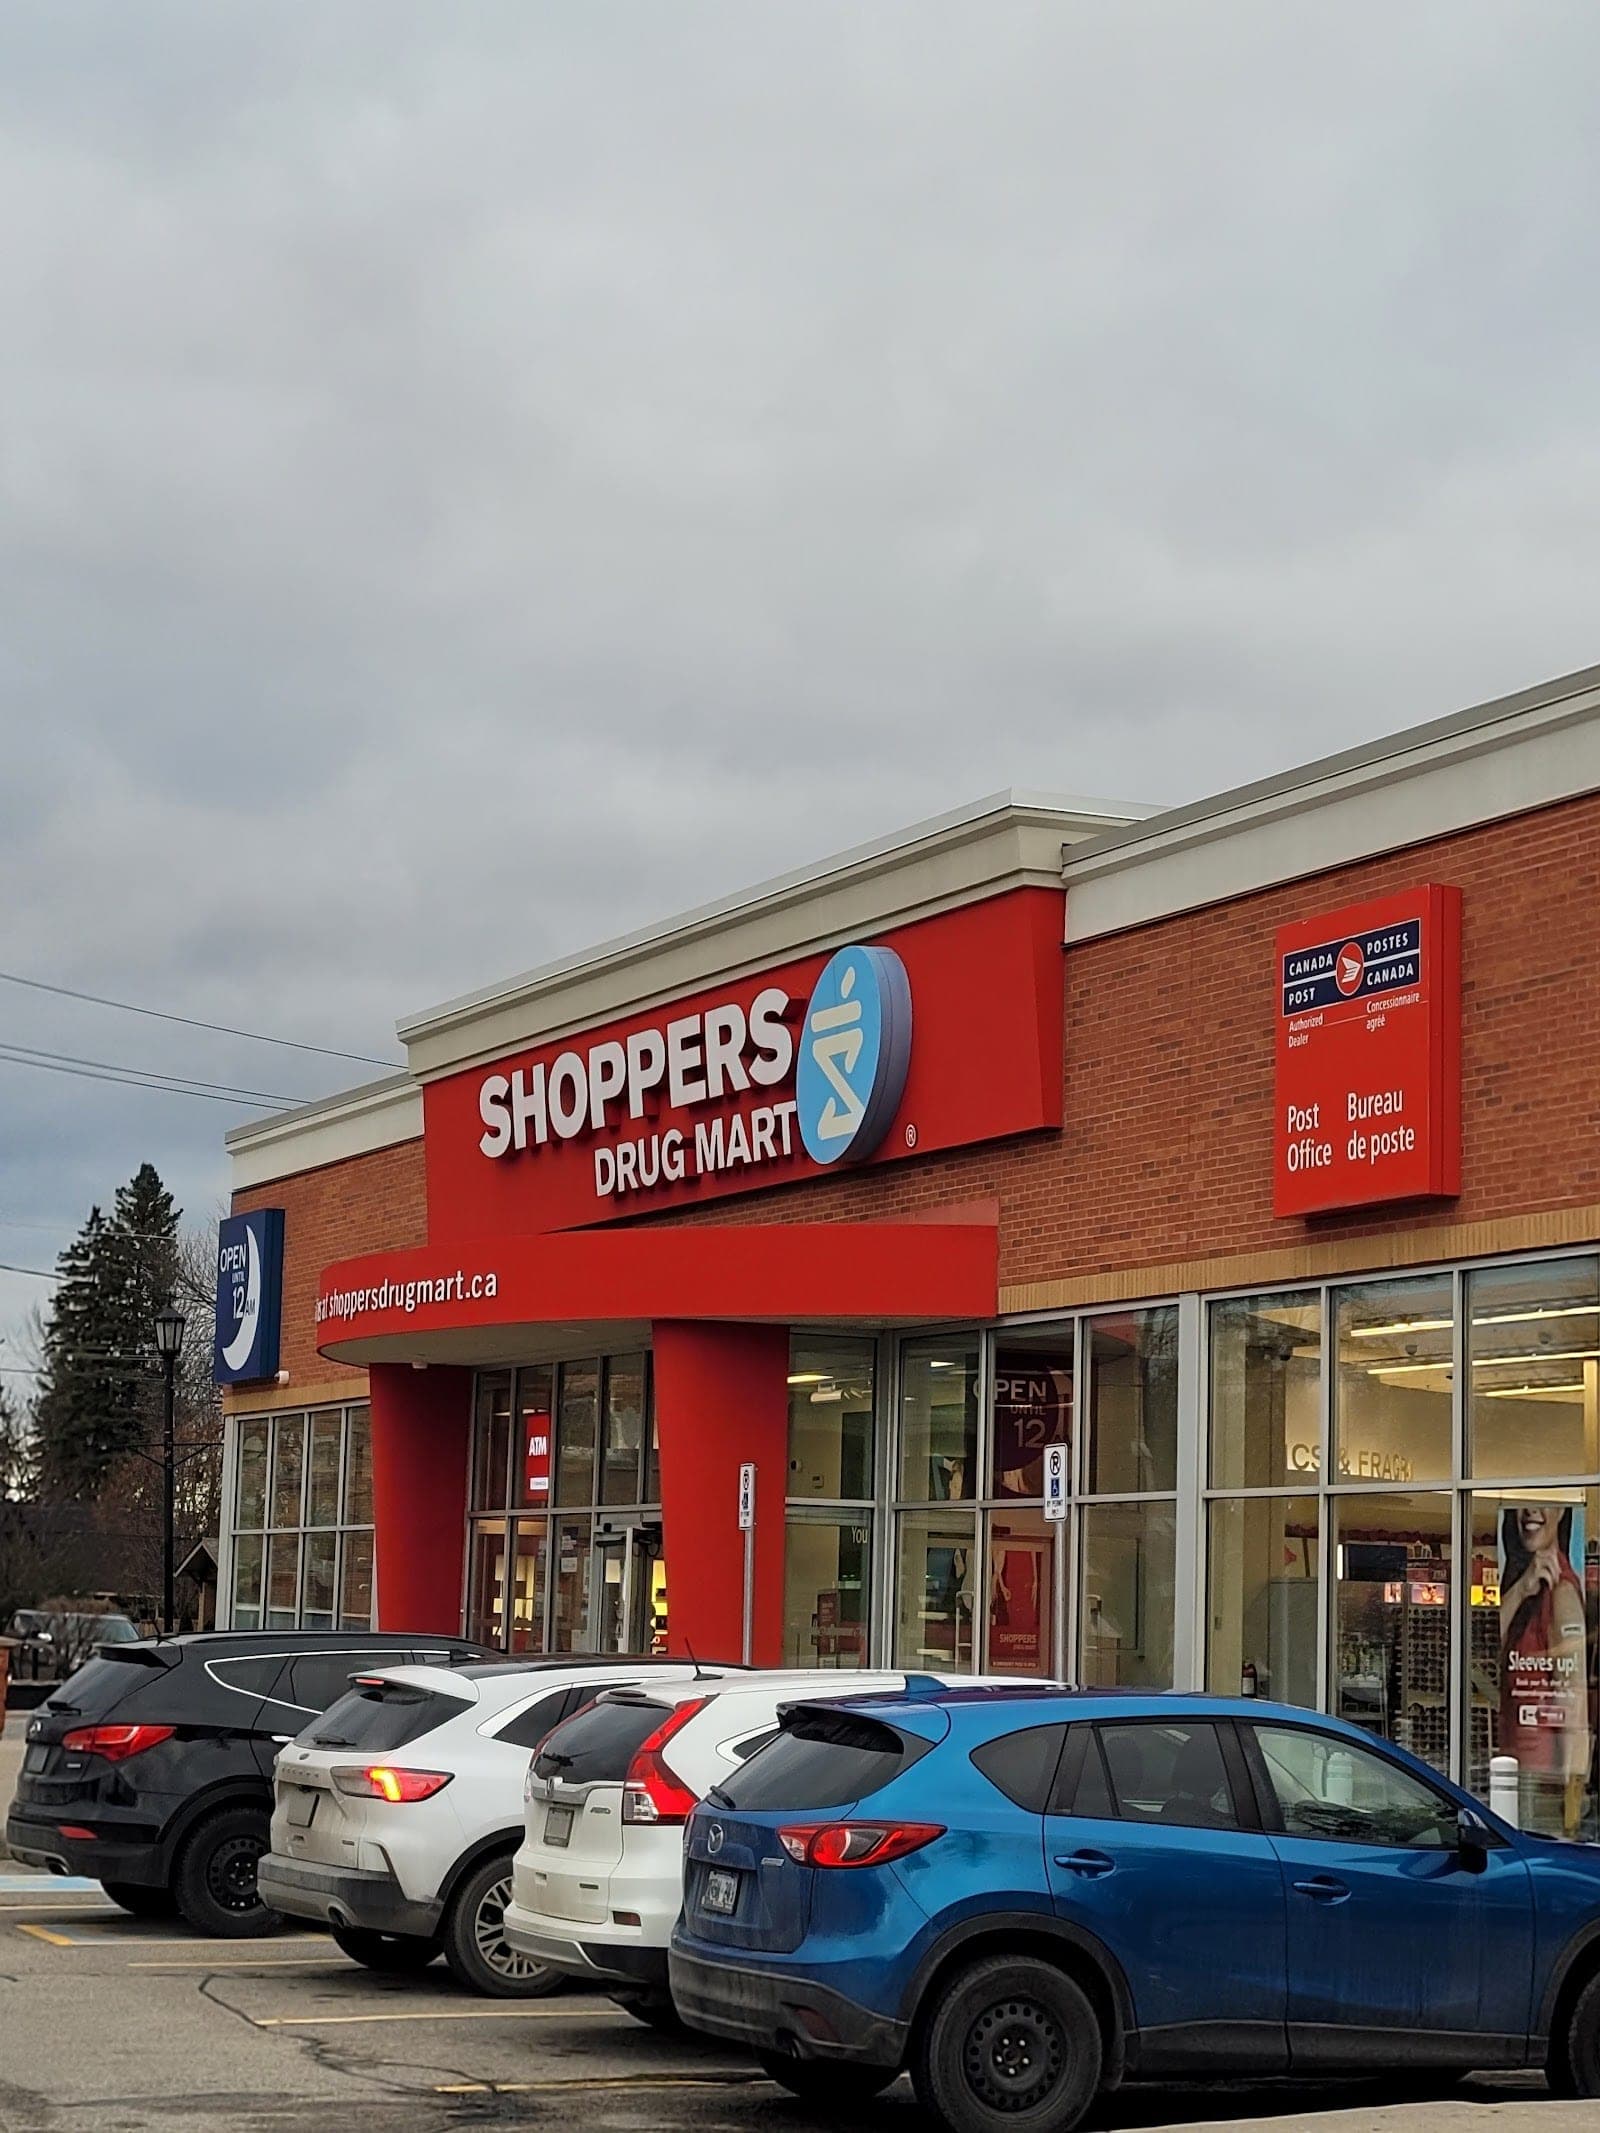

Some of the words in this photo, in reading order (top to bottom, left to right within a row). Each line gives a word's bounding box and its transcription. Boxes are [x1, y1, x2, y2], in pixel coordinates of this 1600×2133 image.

[1367, 932, 1409, 955] POSTES
[1289, 953, 1333, 977] CANADA
[1366, 963, 1414, 986] CANADA
[1288, 987, 1316, 1006] POST
[1366, 991, 1421, 1014] Concessionnaire
[1289, 1013, 1324, 1032] Authorized
[1288, 1034, 1309, 1048] Dealer
[479, 988, 793, 1158] SHOPPERS
[1287, 1103, 1320, 1134] Post
[1347, 1089, 1403, 1122] Bureau
[594, 1129, 685, 1197] DRUG
[694, 1100, 797, 1174] MART
[1287, 1138, 1332, 1172] Office
[1347, 1129, 1366, 1161] de
[1371, 1124, 1415, 1165] poste
[220, 1243, 247, 1273] OPEN
[231, 1271, 246, 1283] UNTIL
[232, 1285, 244, 1319] 12
[244, 1299, 256, 1316] AM
[329, 1270, 497, 1322] shoppersdrugmart.ca
[528, 1436, 547, 1457] ATM
[1013, 1418, 1046, 1448] 12
[1000, 1633, 1037, 1643] SHOPPERS
[1508, 1650, 1553, 1671] Sleeves
[1557, 1652, 1579, 1677] up!
